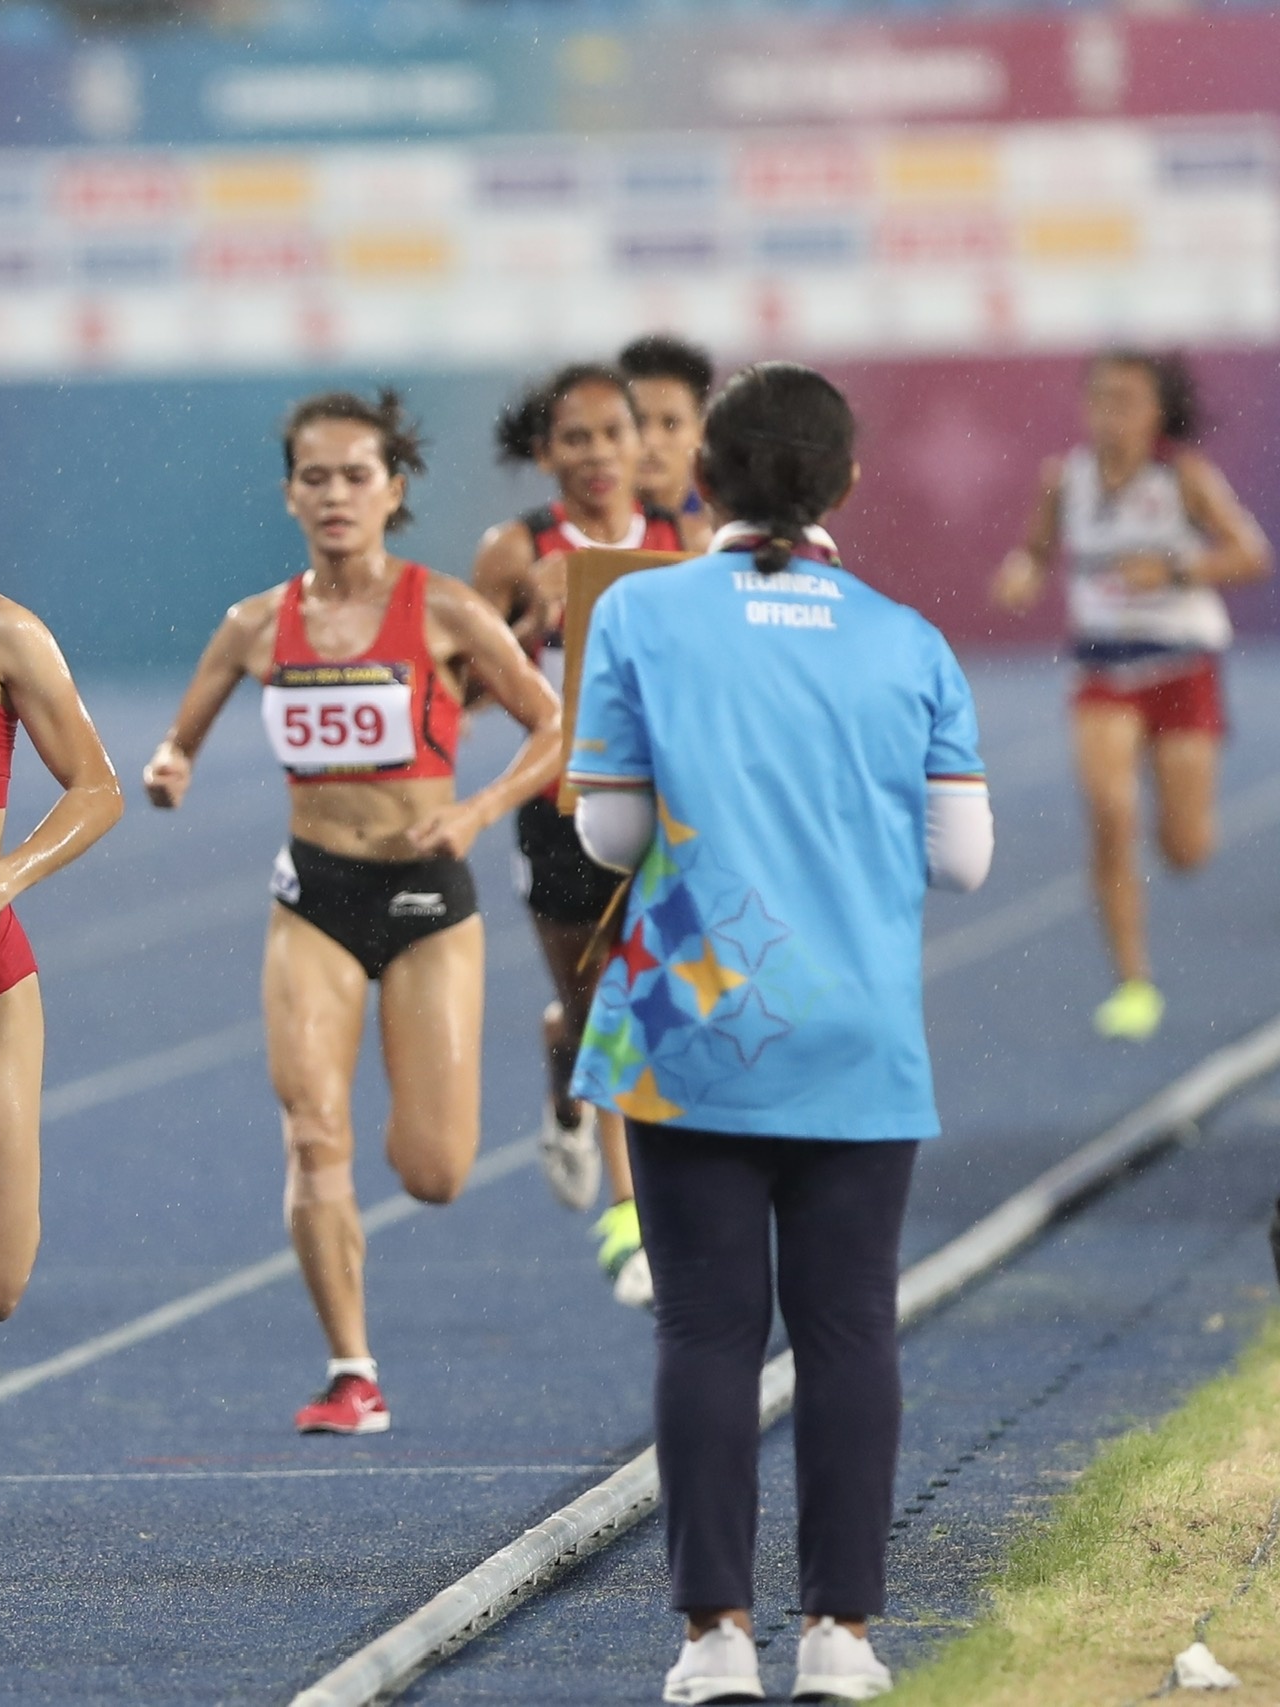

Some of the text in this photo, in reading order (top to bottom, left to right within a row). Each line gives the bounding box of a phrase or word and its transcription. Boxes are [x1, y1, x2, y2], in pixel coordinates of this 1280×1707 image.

[732, 571, 844, 599] TECHNICAL
[746, 601, 837, 629] OFFICIAL
[285, 704, 385, 748] 559
